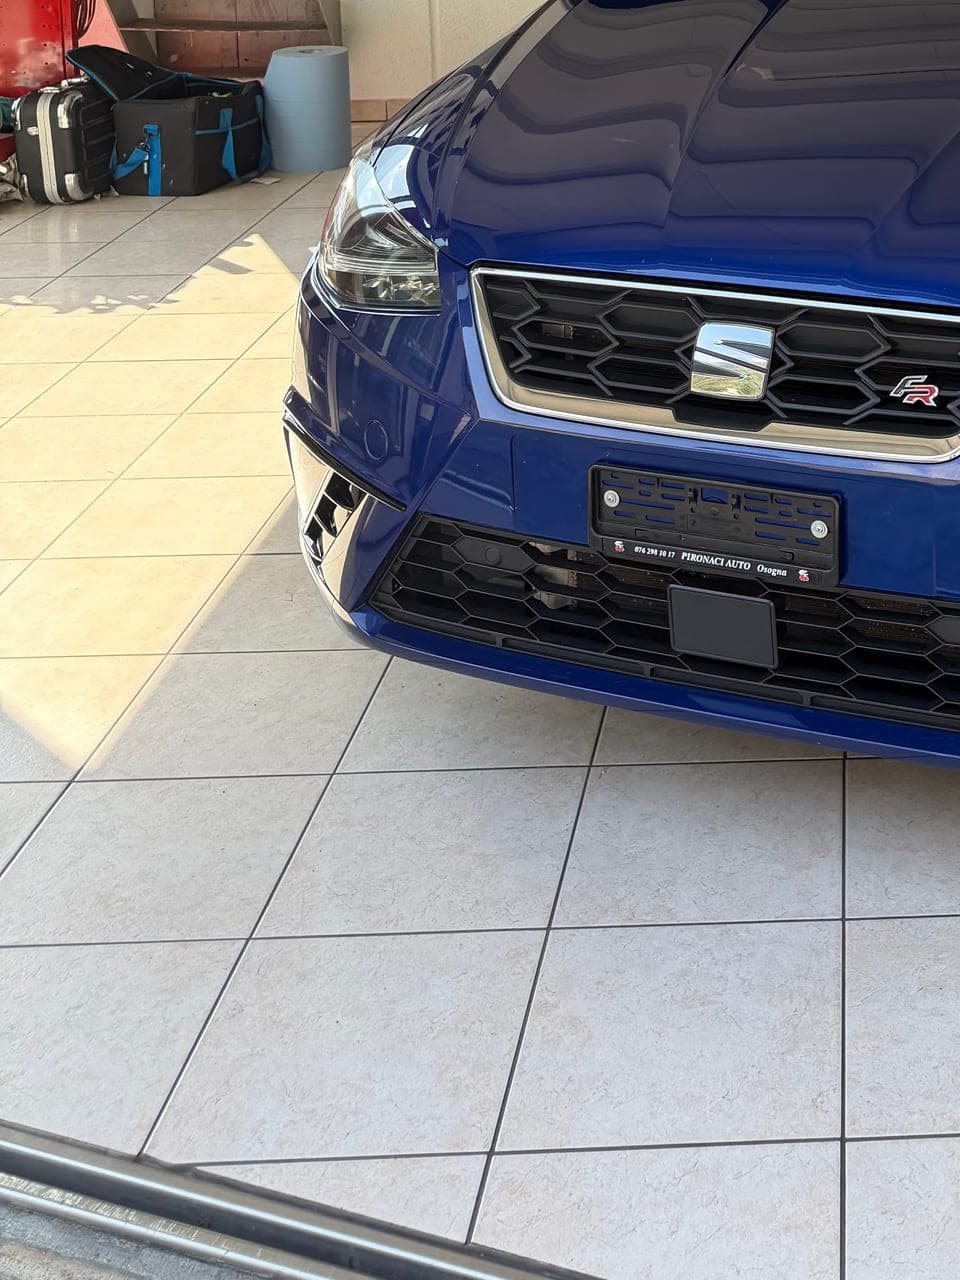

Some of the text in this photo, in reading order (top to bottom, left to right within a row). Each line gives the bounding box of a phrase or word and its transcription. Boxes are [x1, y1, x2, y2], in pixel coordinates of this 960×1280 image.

[889, 375, 939, 407] FR
[634, 546, 646, 554] 076
[667, 551, 676, 559] 17
[681, 552, 725, 566] PIRONACI
[725, 559, 751, 570] AUTO
[756, 564, 787, 577] Osogna
